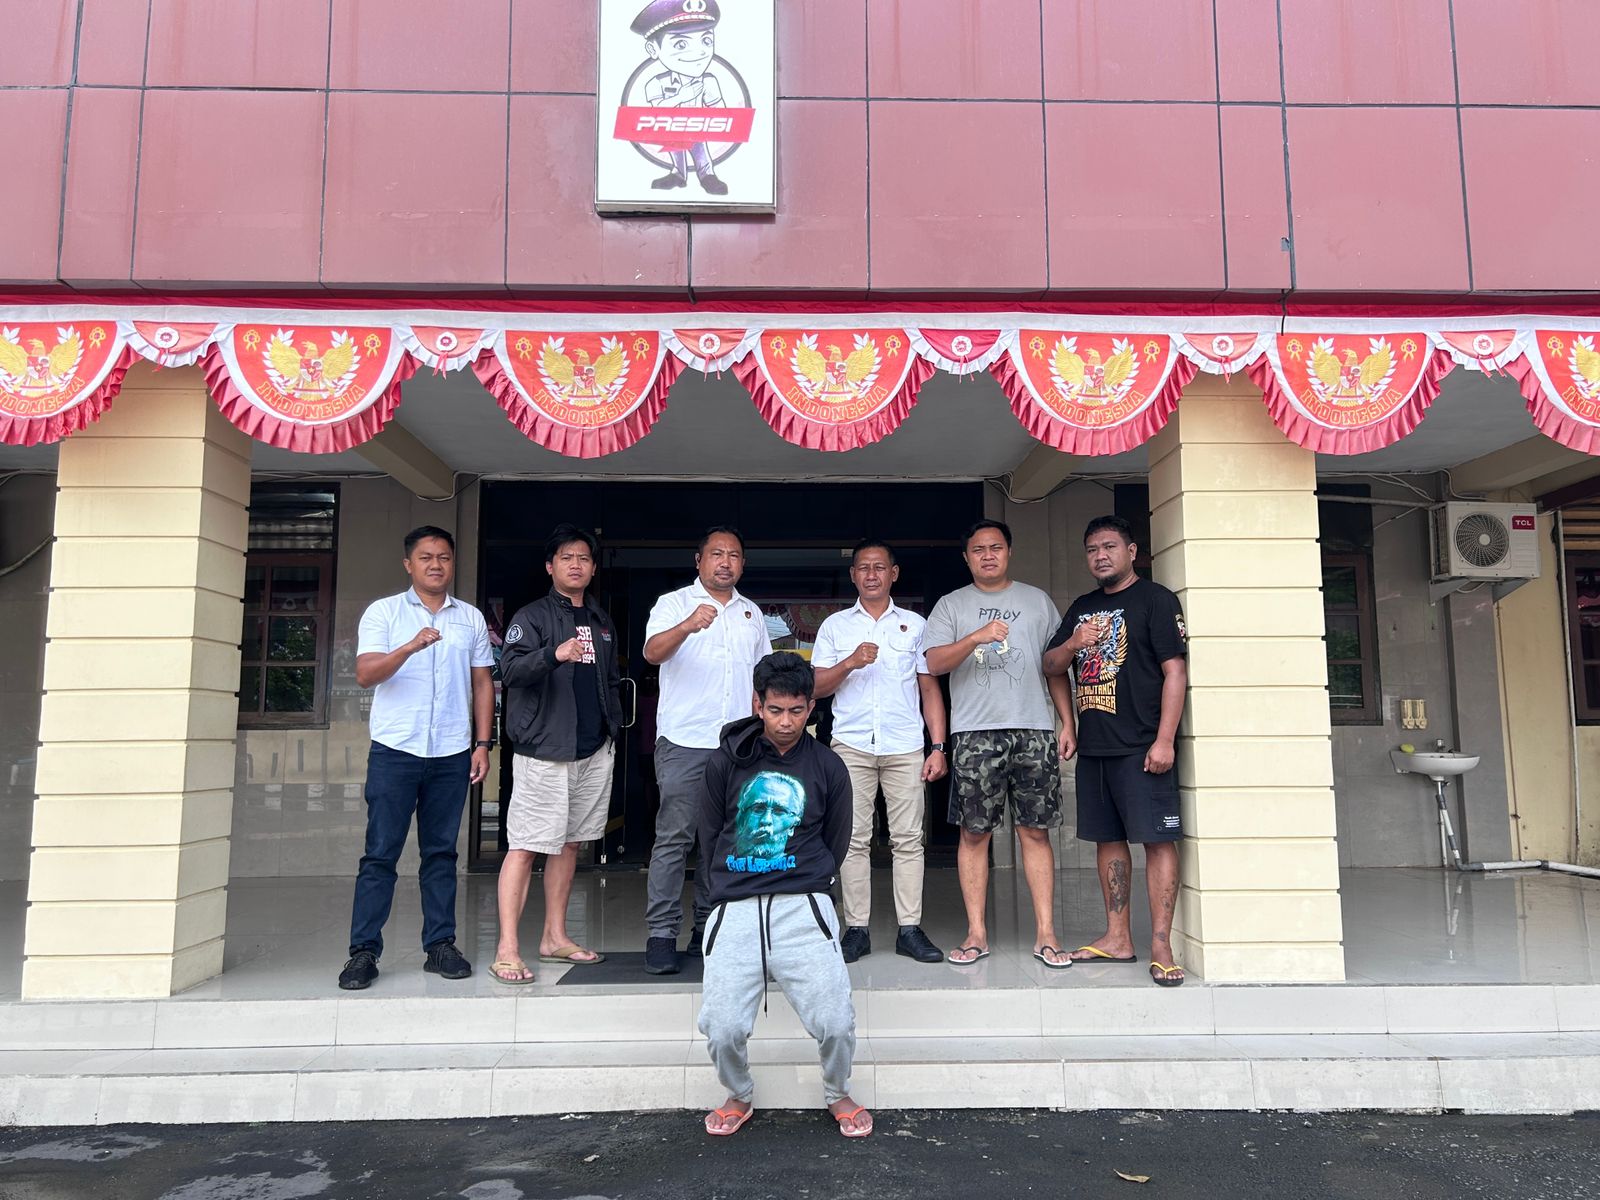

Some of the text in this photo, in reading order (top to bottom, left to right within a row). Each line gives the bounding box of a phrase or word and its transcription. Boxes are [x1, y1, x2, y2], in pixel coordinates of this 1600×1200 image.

[636, 116, 734, 133] PRESISI
[256, 381, 366, 418] INDONESIA
[534, 388, 637, 424] INDONESIA
[786, 385, 889, 421] INDONESIA
[1043, 387, 1146, 424] INDONESIA
[1300, 388, 1403, 424] INDONESIA
